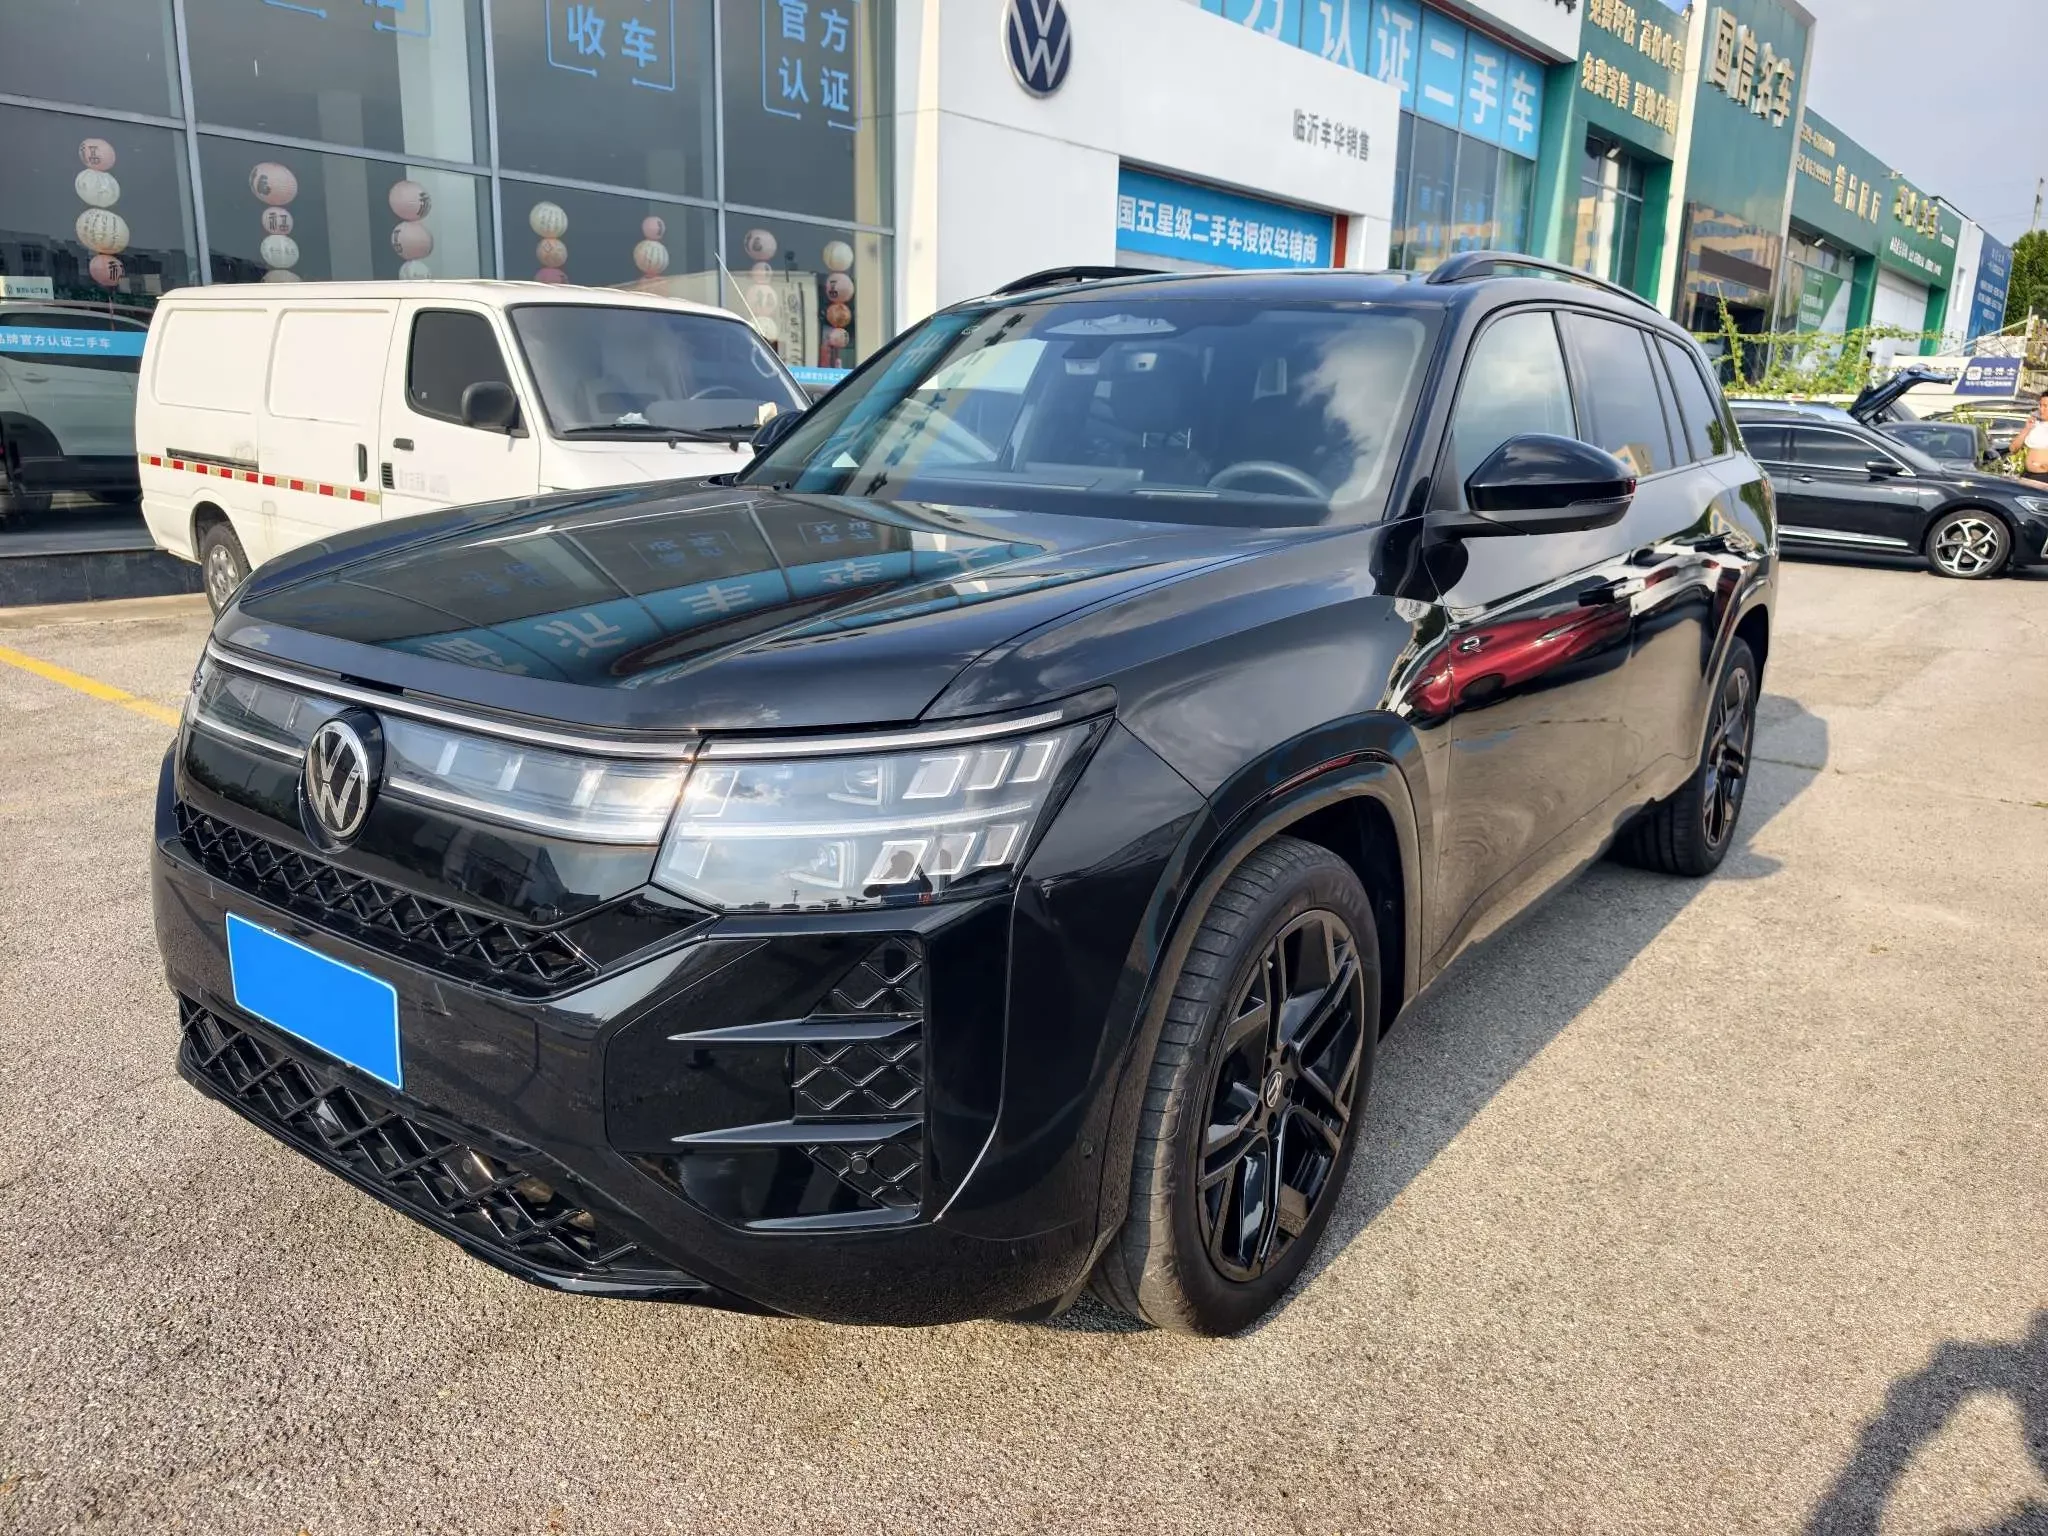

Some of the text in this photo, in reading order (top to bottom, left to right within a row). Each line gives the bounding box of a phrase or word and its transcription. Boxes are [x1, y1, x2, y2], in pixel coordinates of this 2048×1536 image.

[566, 5, 657, 67] 收车
[779, 0, 850, 53] 官方
[778, 57, 850, 113] 认证
[1581, 51, 1631, 111] 免费寄售
[1705, 6, 1795, 128] 国信名车
[1293, 108, 1370, 162] 临沂丰华销售
[1117, 194, 1318, 265] 国五星级二手车授权经销商
[306, 721, 368, 838] VW
